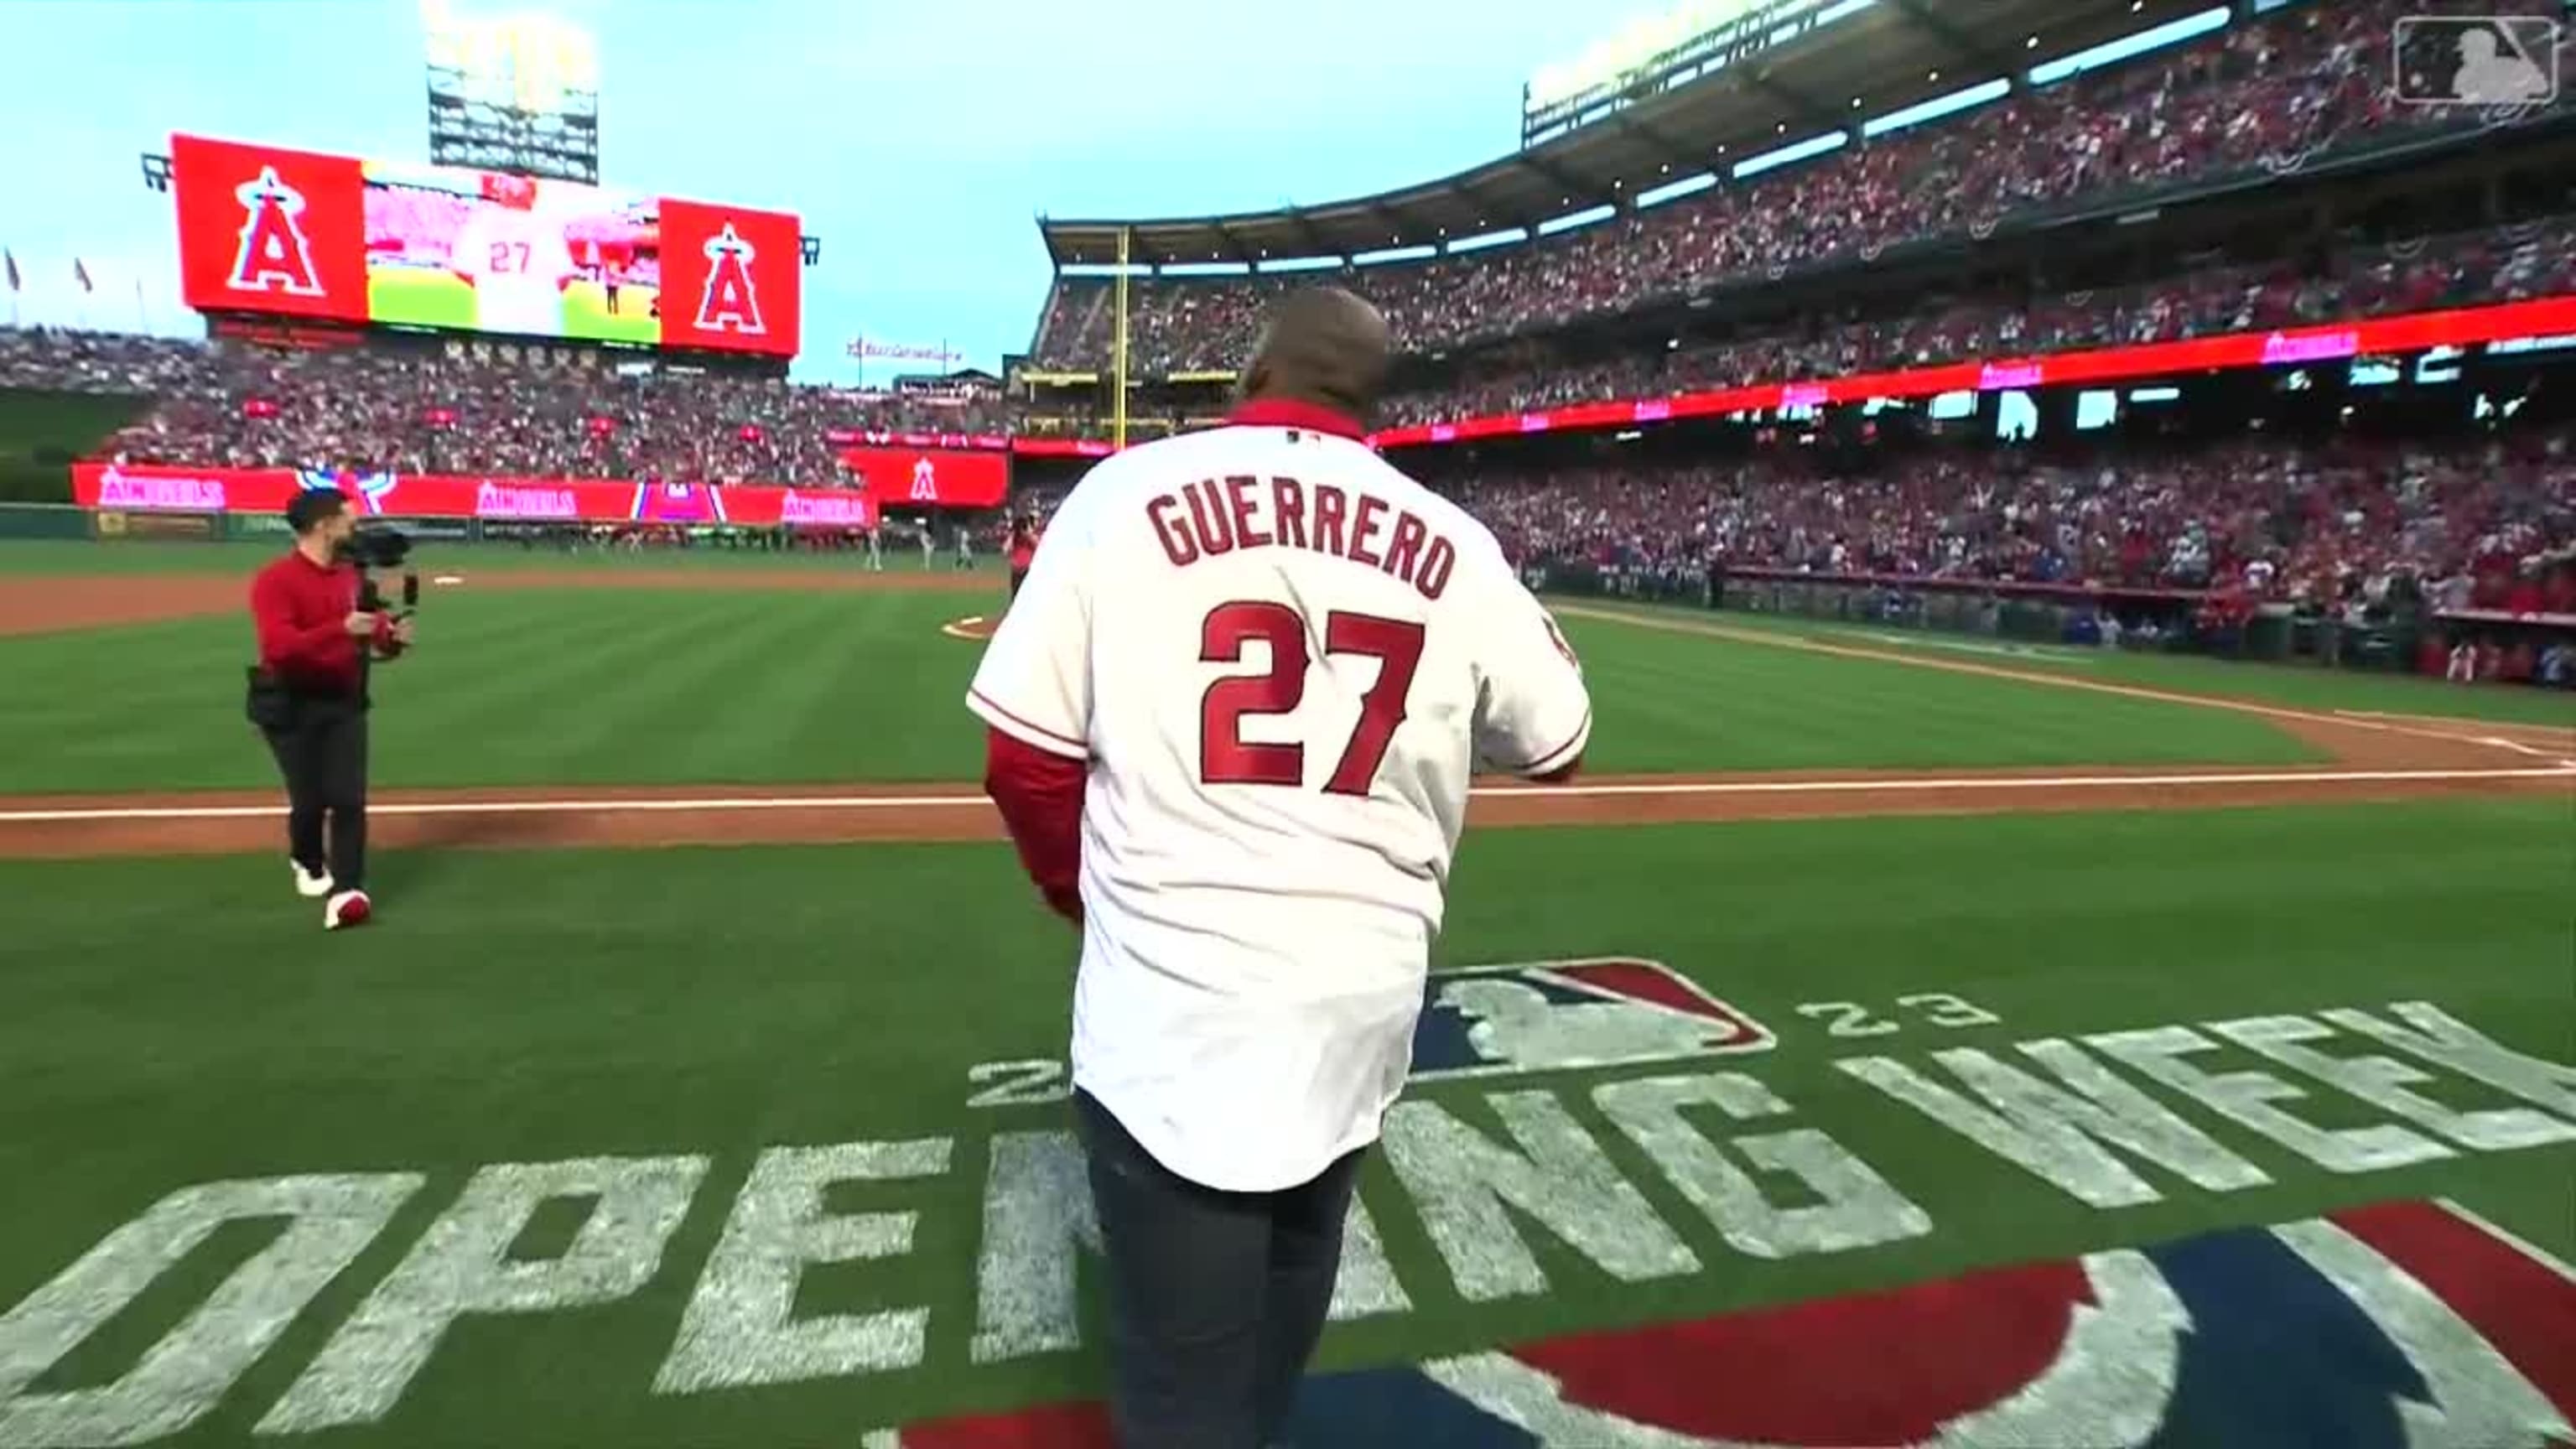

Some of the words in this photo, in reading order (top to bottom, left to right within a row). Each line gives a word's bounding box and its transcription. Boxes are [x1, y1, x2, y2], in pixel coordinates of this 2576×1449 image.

[226, 164, 328, 299] A
[490, 241, 531, 274] 27
[692, 221, 767, 335] A
[1146, 475, 1457, 600] GUERRERO
[1198, 600, 1426, 797] 27
[1794, 994, 2002, 1037] 23
[1834, 1000, 2576, 1209] WEEK
